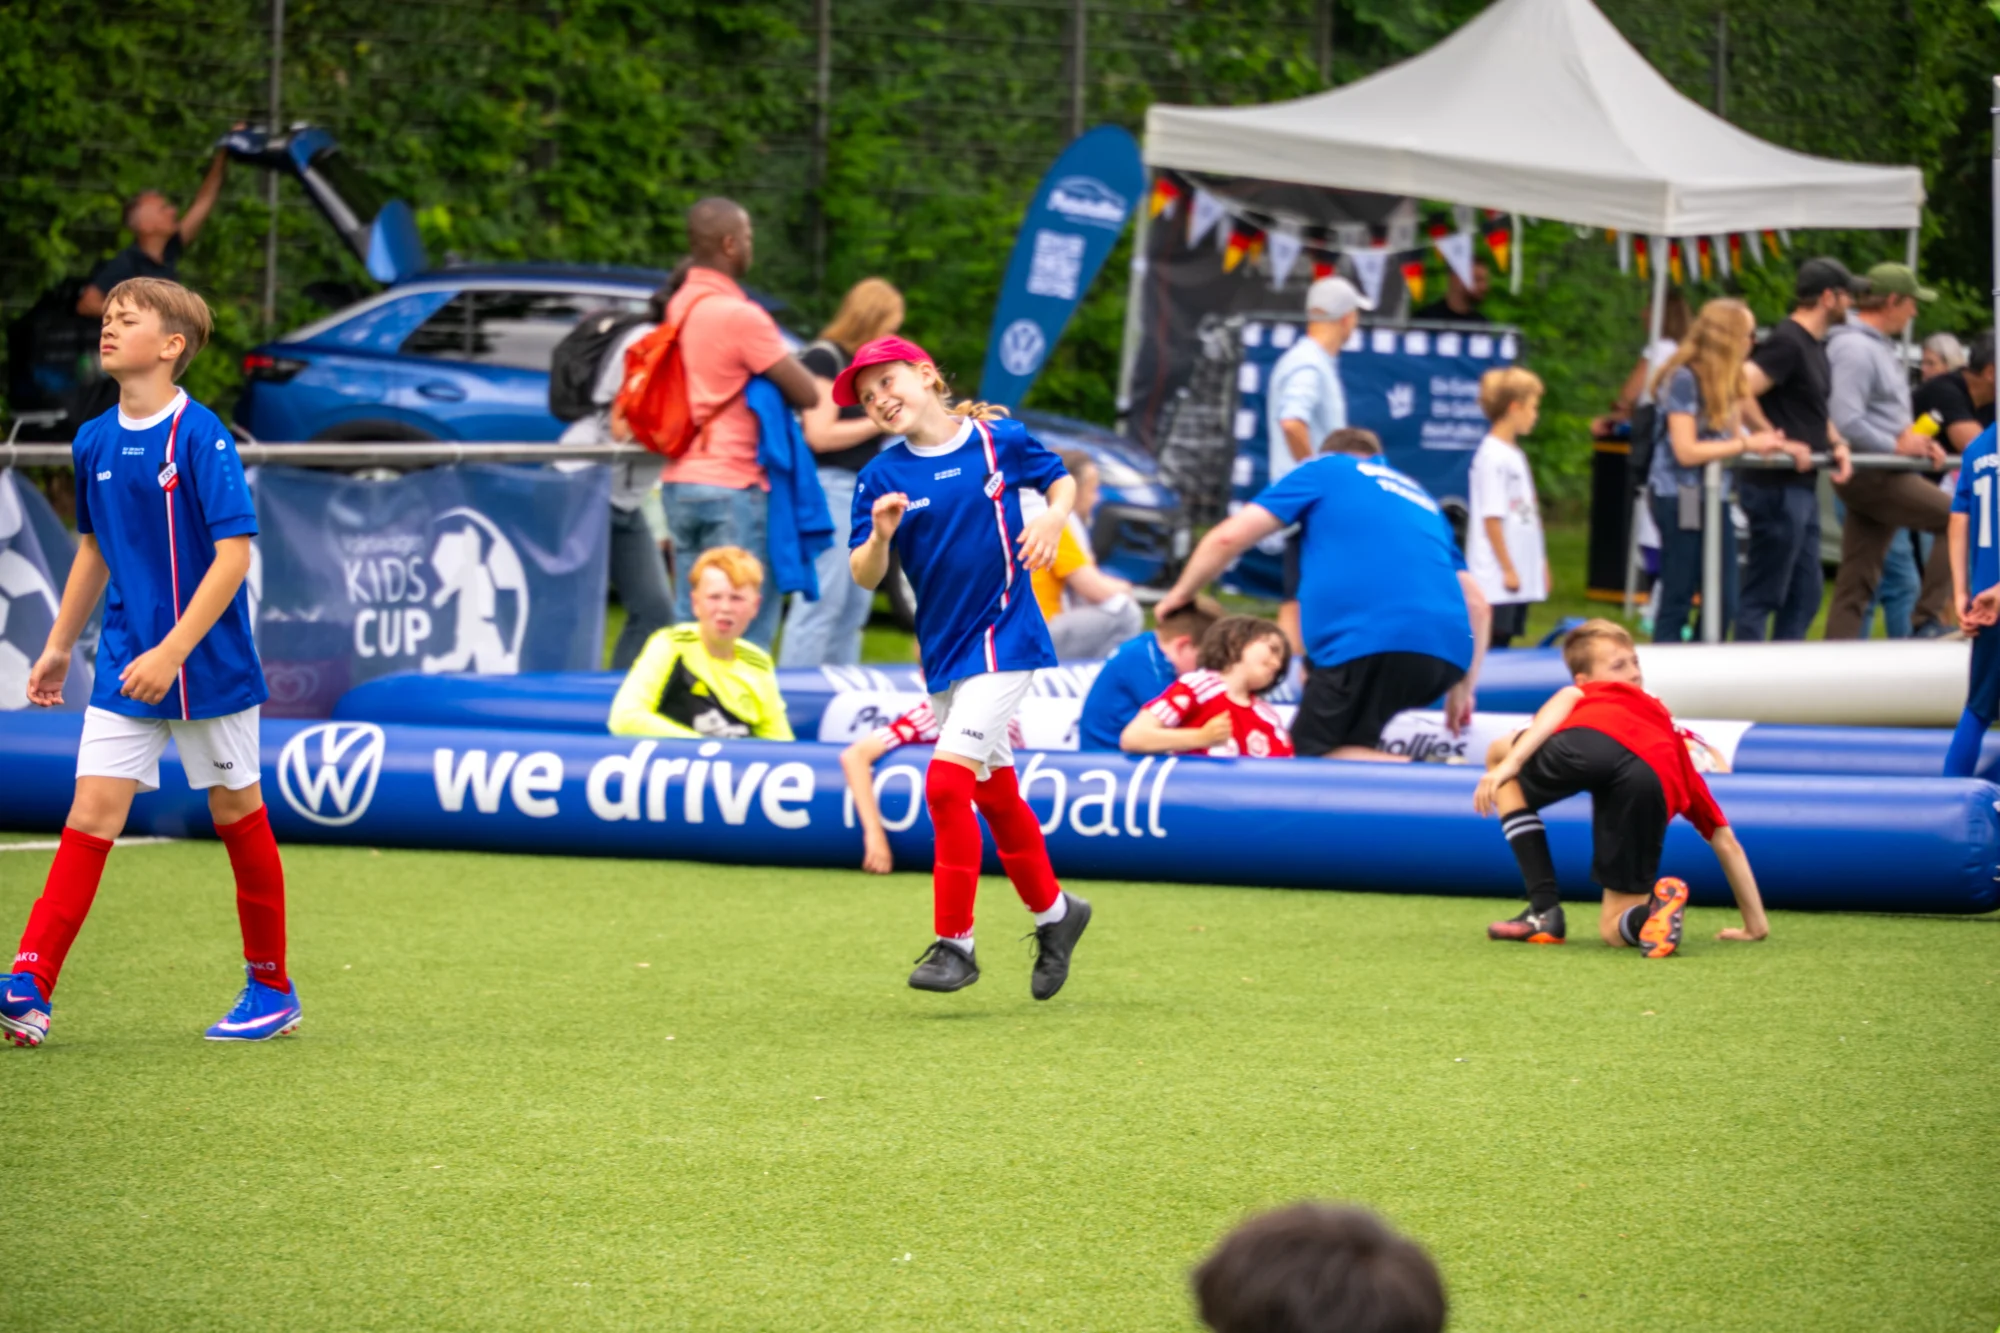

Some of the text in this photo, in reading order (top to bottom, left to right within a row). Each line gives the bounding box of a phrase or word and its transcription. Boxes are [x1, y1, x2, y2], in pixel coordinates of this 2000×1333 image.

[343, 556, 428, 604] KIDS
[355, 608, 432, 658] CUP
[433, 747, 565, 818] we
[586, 740, 816, 830] drive
[14, 951, 39, 962] AKO
